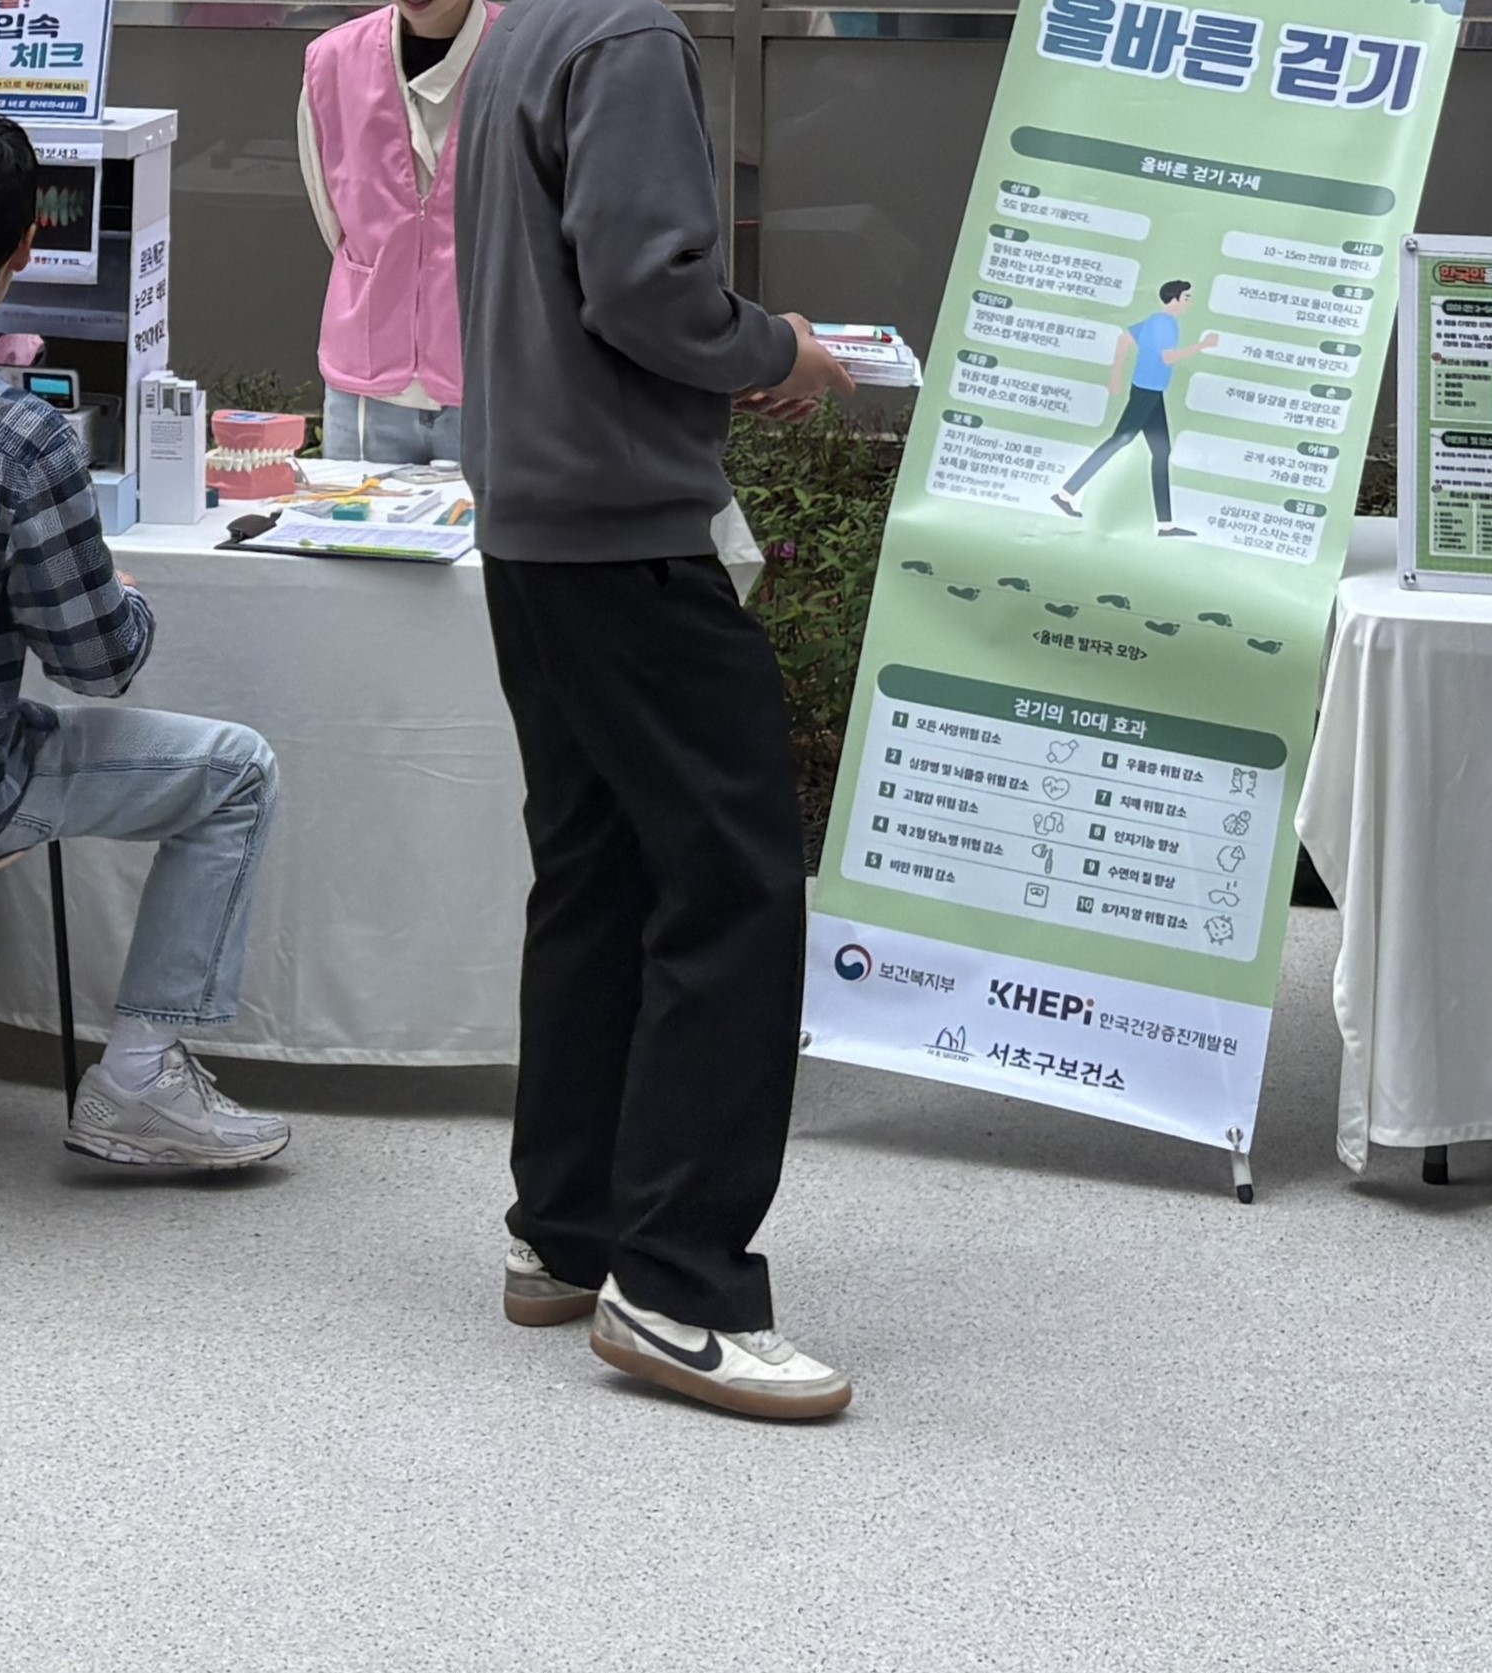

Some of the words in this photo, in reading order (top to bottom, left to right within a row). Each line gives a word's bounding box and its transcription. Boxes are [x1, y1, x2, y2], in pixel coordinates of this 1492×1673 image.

[10, 42, 84, 68] 체크
[1276, 27, 1422, 111] 걷기
[1140, 156, 1188, 182] 올바른
[1193, 165, 1224, 186] 걷기
[1227, 170, 1261, 192] 자세
[1020, 201, 1048, 216] 앞으로
[1023, 247, 1071, 266] 자연스럽게
[986, 268, 1034, 287] 자연스럽게
[1046, 265, 1064, 278] 또는
[1084, 273, 1123, 290] 모양으로
[1239, 285, 1289, 304] 자연스럽게
[1290, 295, 1310, 307] 코로
[1333, 301, 1363, 315] 마시고
[1017, 315, 1045, 330] 심하게
[1242, 345, 1262, 358] 가슴
[1296, 355, 1317, 367] 살짝
[1318, 358, 1350, 372] 당긴다.
[1001, 377, 1039, 393] 시작으로
[1018, 394, 1069, 414] 이동시킨다.
[1301, 401, 1341, 415] 모양으로
[1283, 411, 1313, 426] 가볍게
[942, 442, 962, 456] 자기
[945, 428, 966, 443] 자기
[1004, 440, 1021, 453] 100
[970, 461, 1008, 478] 일정하게
[1270, 470, 1300, 484] 가슴을
[1032, 629, 1075, 651] <올바른
[1076, 636, 1114, 657] 발자국
[1115, 643, 1148, 662] 모양>
[1013, 697, 1065, 724] 걷기의
[1069, 708, 1109, 733] 10대
[1111, 715, 1148, 740] 효과
[916, 718, 937, 733] 모든
[981, 730, 1002, 744] 감소
[986, 772, 1007, 787] 위험
[1009, 777, 1030, 792] 감소
[1159, 764, 1181, 778] 위험
[1182, 769, 1204, 783] 감소
[936, 795, 957, 809] 위험
[958, 799, 979, 814] 감소
[1143, 799, 1164, 814] 위험
[1165, 804, 1187, 819] 감소
[960, 837, 982, 851] 위험
[983, 842, 1004, 856] 감소
[1114, 831, 1156, 849] 인지기능
[1158, 839, 1180, 854] 향상
[912, 865, 933, 879] 위험
[935, 869, 956, 883] 감소
[1108, 866, 1139, 882] 수면의
[1079, 900, 1092, 910] 10
[1144, 911, 1165, 927] 위험
[1167, 915, 1188, 929] 감소
[878, 961, 956, 994] 보건복지부
[987, 979, 1095, 1026] KHEPi
[1099, 1012, 1238, 1057] 한국건강증진개발원
[985, 1042, 1126, 1091] 서초구보건소
